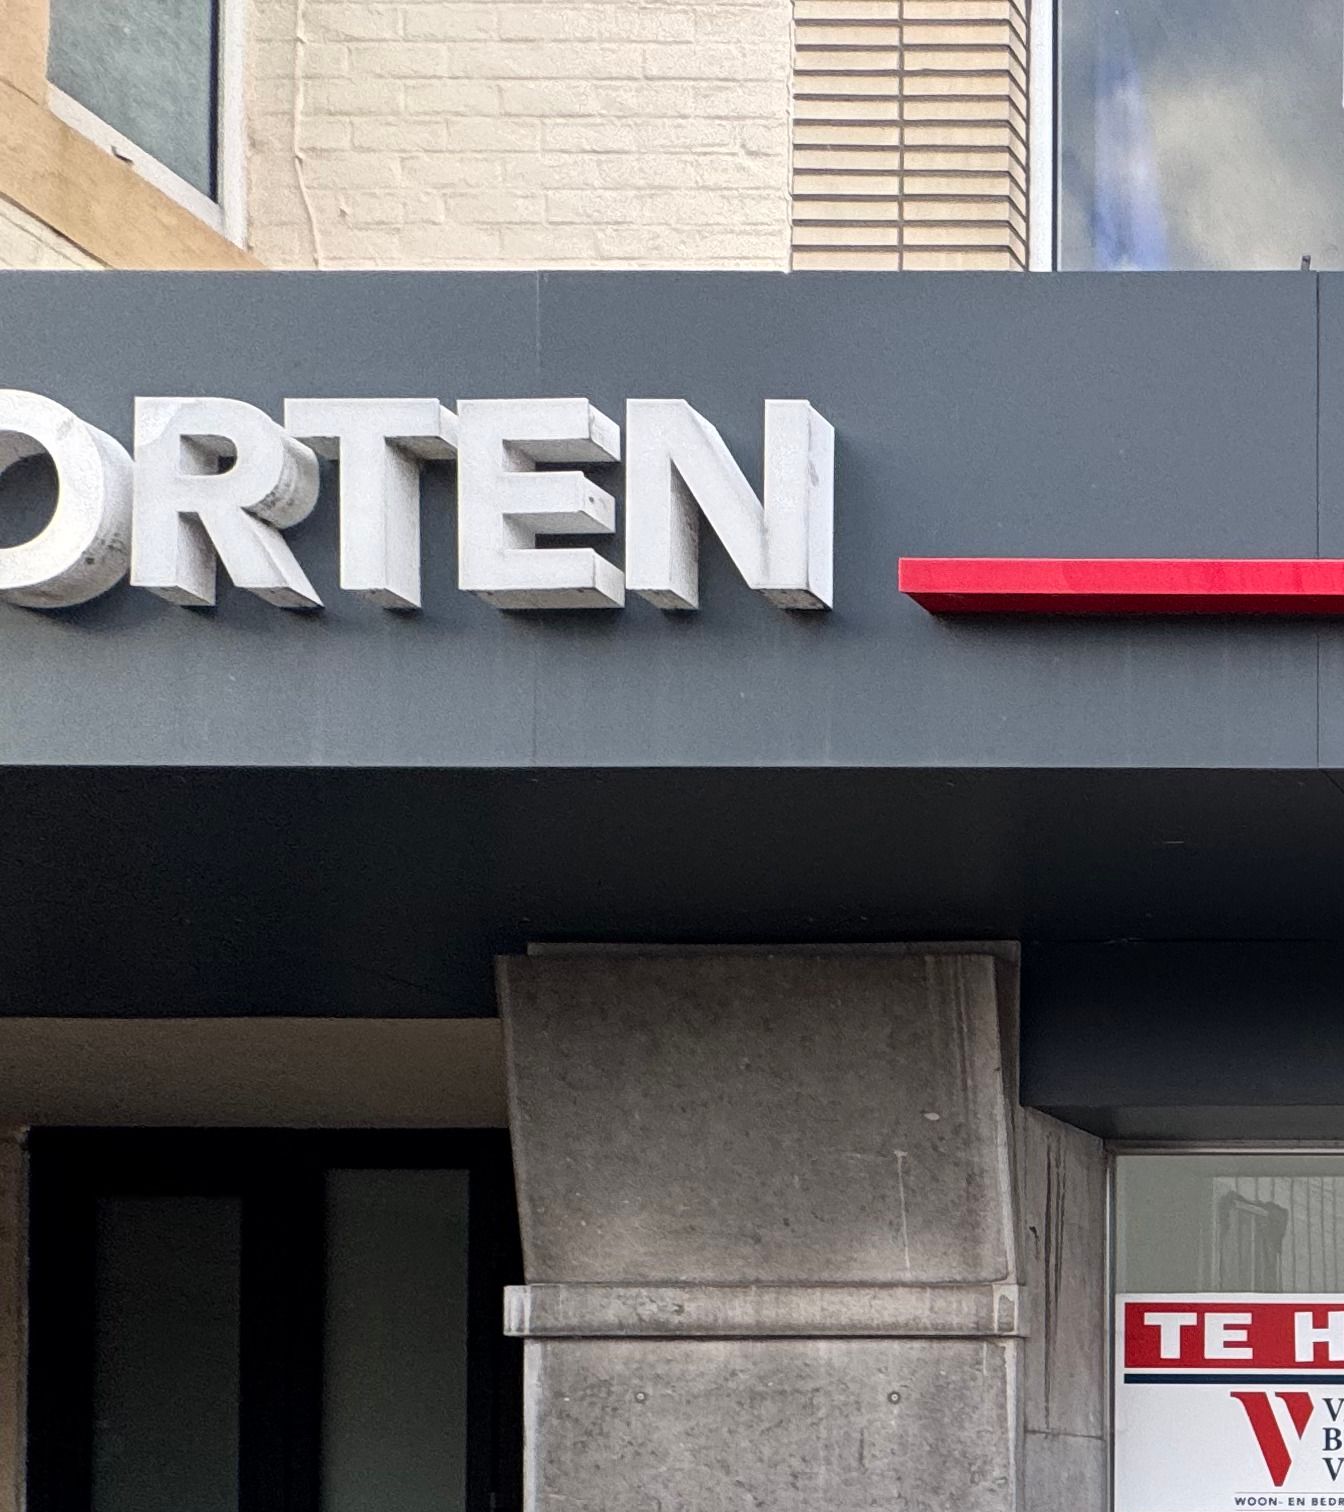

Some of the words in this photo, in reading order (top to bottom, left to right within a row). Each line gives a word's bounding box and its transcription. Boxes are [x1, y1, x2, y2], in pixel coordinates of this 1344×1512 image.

[1144, 1312, 1253, 1360] TE
[1234, 1496, 1283, 1506] WOON-
[1288, 1497, 1305, 1506] EN
